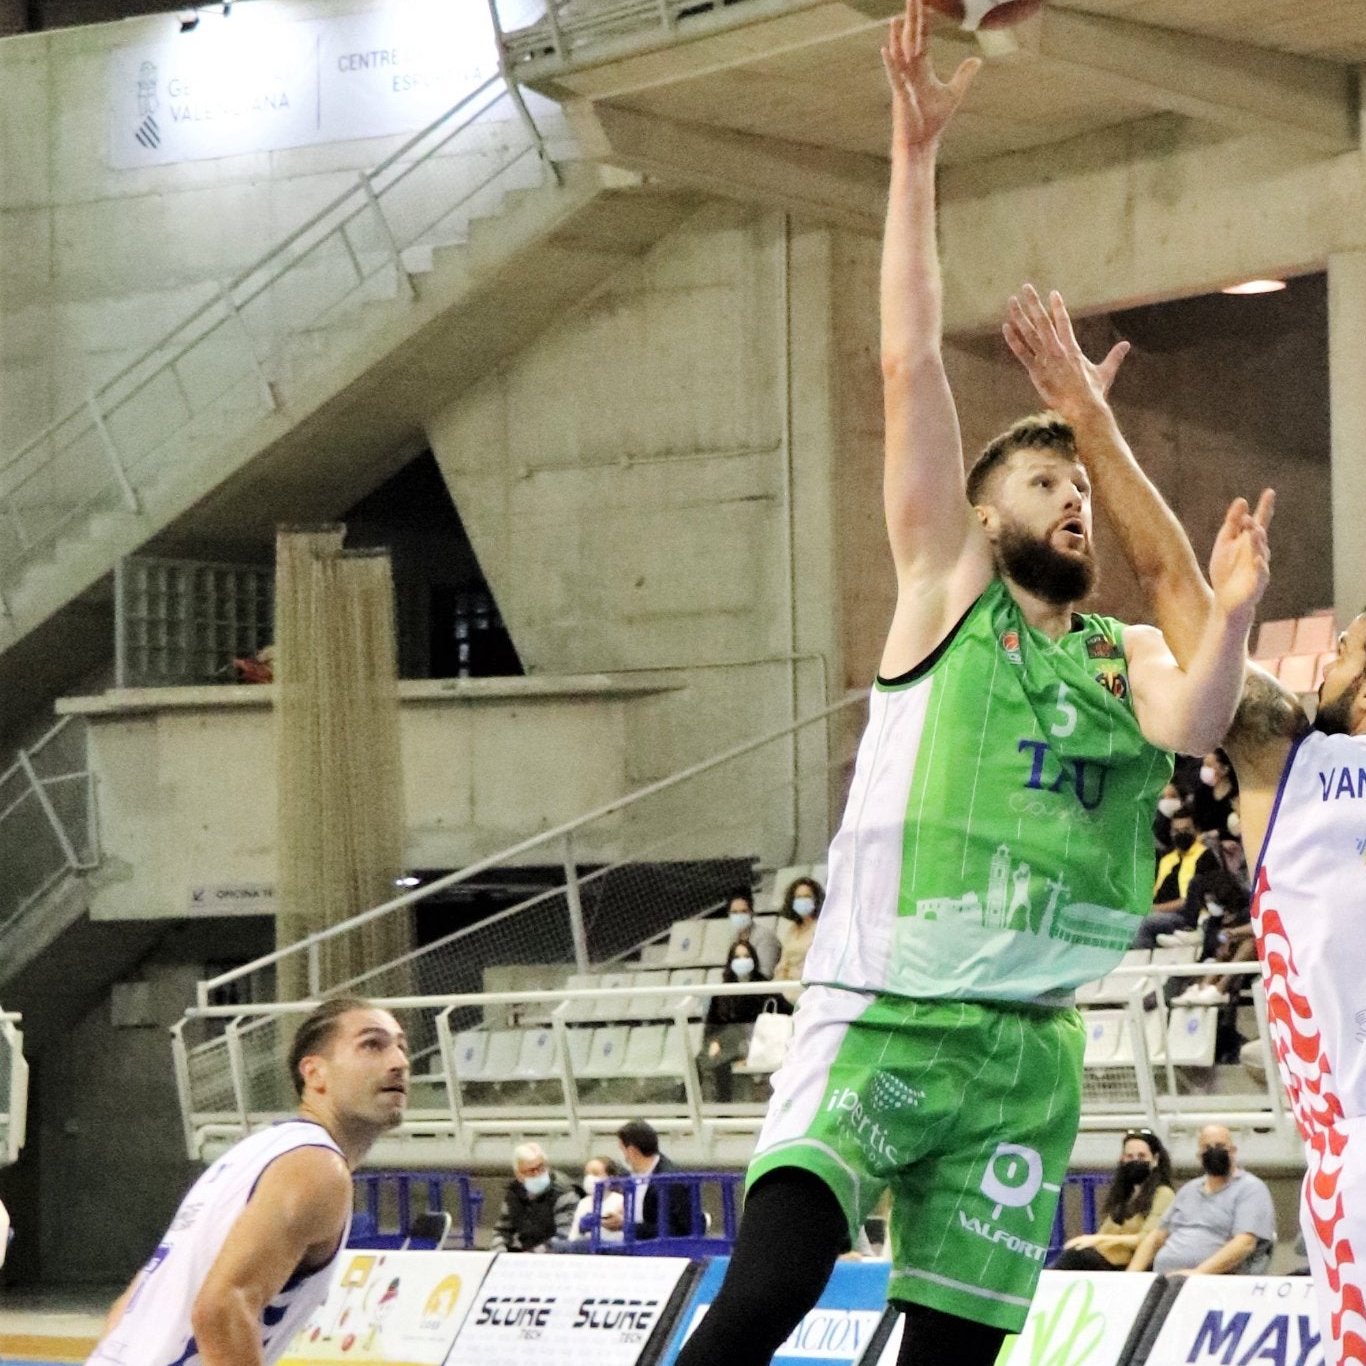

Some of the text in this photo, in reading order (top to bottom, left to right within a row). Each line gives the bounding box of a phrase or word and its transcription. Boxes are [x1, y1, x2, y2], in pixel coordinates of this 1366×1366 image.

[336, 47, 399, 74] CENTRE
[1050, 681, 1079, 738] 5
[826, 1086, 899, 1166] ibertic
[475, 1296, 557, 1327] SCORE
[572, 1298, 659, 1330] SCORE
